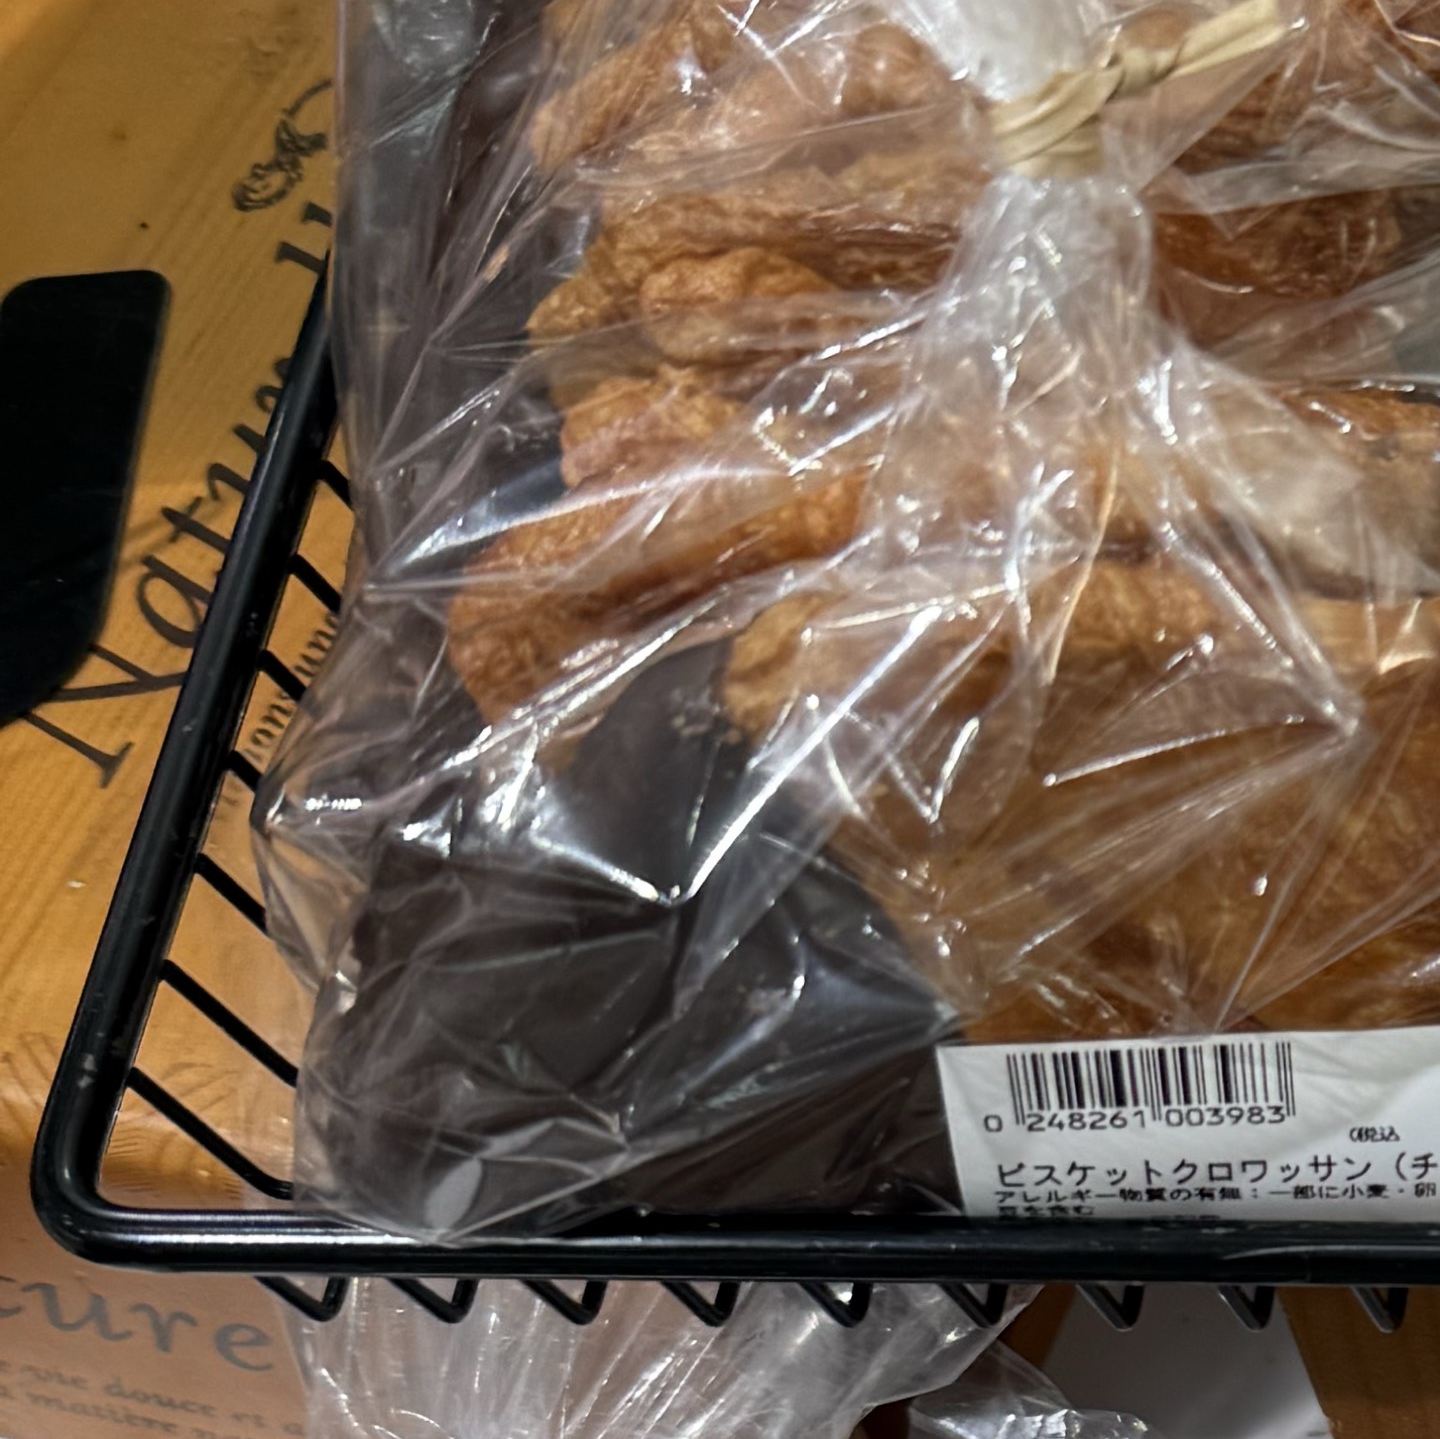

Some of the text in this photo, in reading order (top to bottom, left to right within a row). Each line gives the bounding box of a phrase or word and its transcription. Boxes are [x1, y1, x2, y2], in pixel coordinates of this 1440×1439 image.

[984, 1105, 1287, 1133] 0 248261 003983
